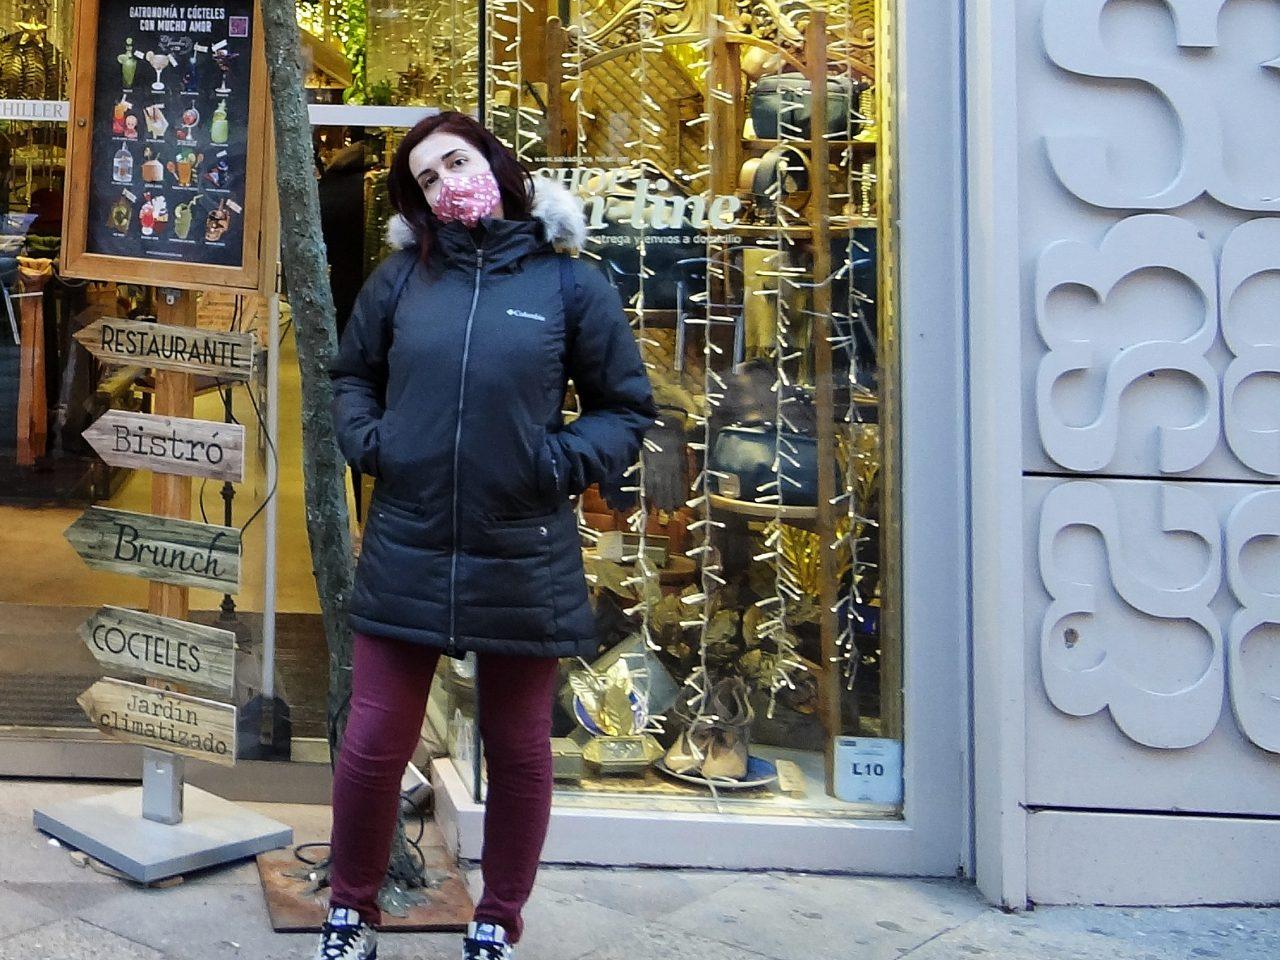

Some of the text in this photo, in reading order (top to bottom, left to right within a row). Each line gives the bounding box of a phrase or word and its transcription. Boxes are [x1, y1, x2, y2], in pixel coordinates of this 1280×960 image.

[140, 20, 212, 32] CON MUCHO AMOR
[180, 7, 186, 19] Y
[187, 5, 226, 20] CÓCTELES
[583, 178, 742, 230] n-line
[682, 235, 690, 244] a
[101, 325, 242, 368] RESTAURANTE
[111, 425, 224, 465] Bistró
[113, 521, 226, 578] Brunch
[93, 619, 201, 673] CÓCTELES
[126, 694, 199, 726] Jardín
[100, 711, 228, 755] climatizado
[852, 763, 884, 776] L10
